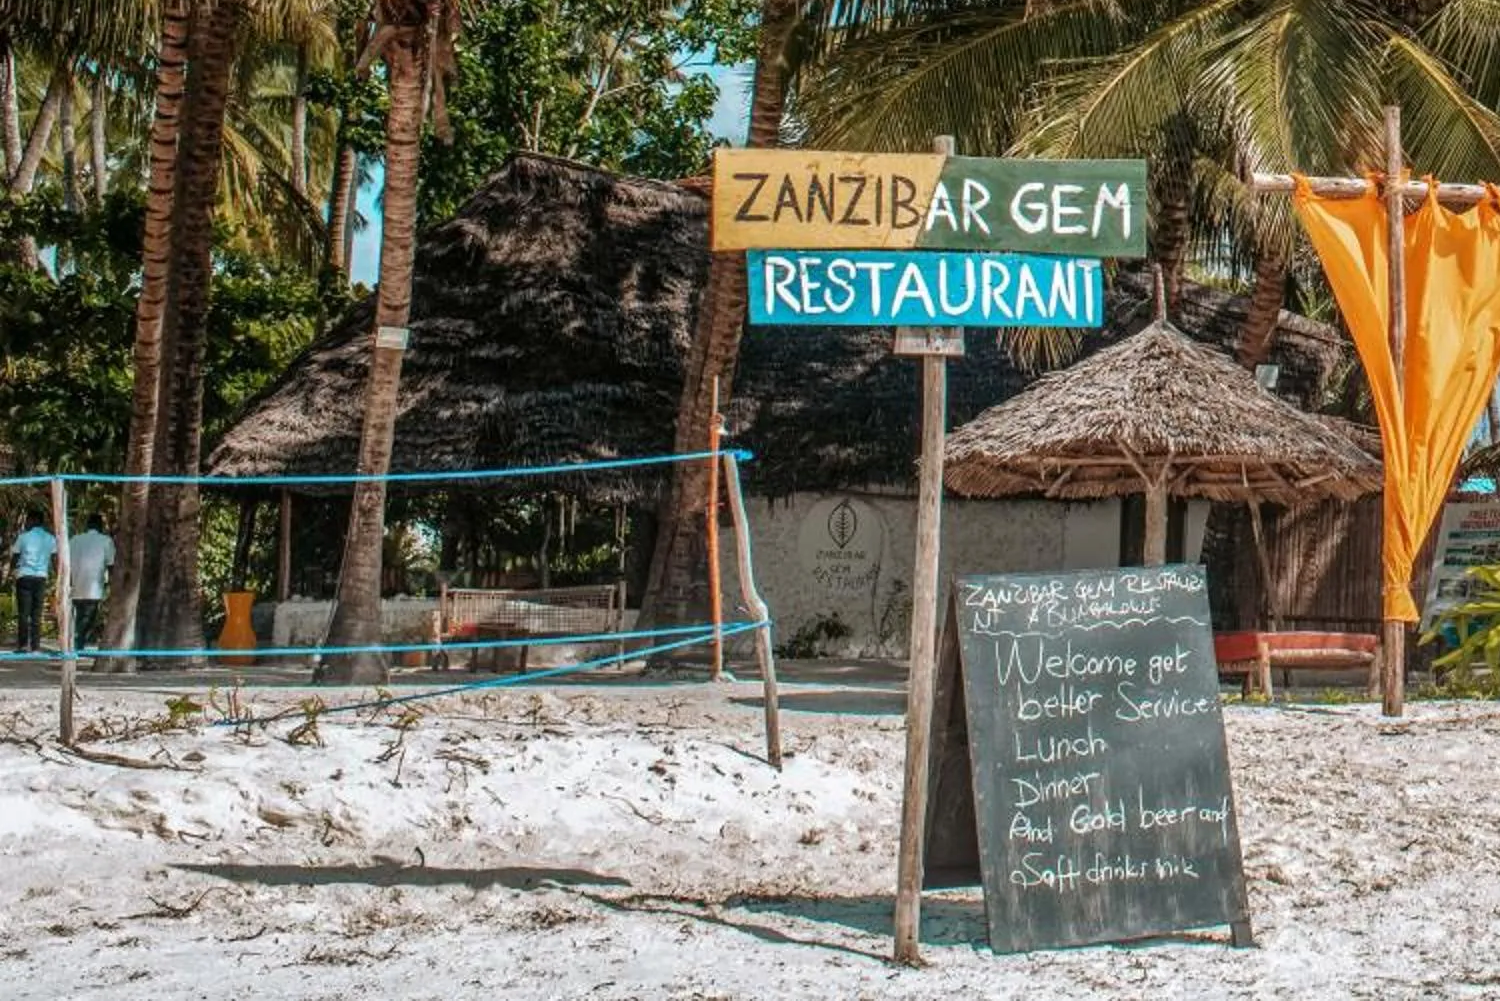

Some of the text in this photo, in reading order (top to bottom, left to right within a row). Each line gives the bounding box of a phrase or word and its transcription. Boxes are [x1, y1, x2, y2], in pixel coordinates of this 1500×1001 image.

[732, 171, 1131, 240] ZANZIBAR GEM
[764, 255, 1103, 324] RESTAURANT
[1074, 576, 1116, 601] GEM
[995, 637, 1193, 687] Welcome get
[1016, 680, 1103, 721] better
[1014, 726, 1109, 764] Lunch
[1009, 770, 1101, 809] Dinner
[1138, 783, 1197, 830] beer
[1009, 851, 1081, 894] Soft
[1085, 851, 1149, 885] drinks
